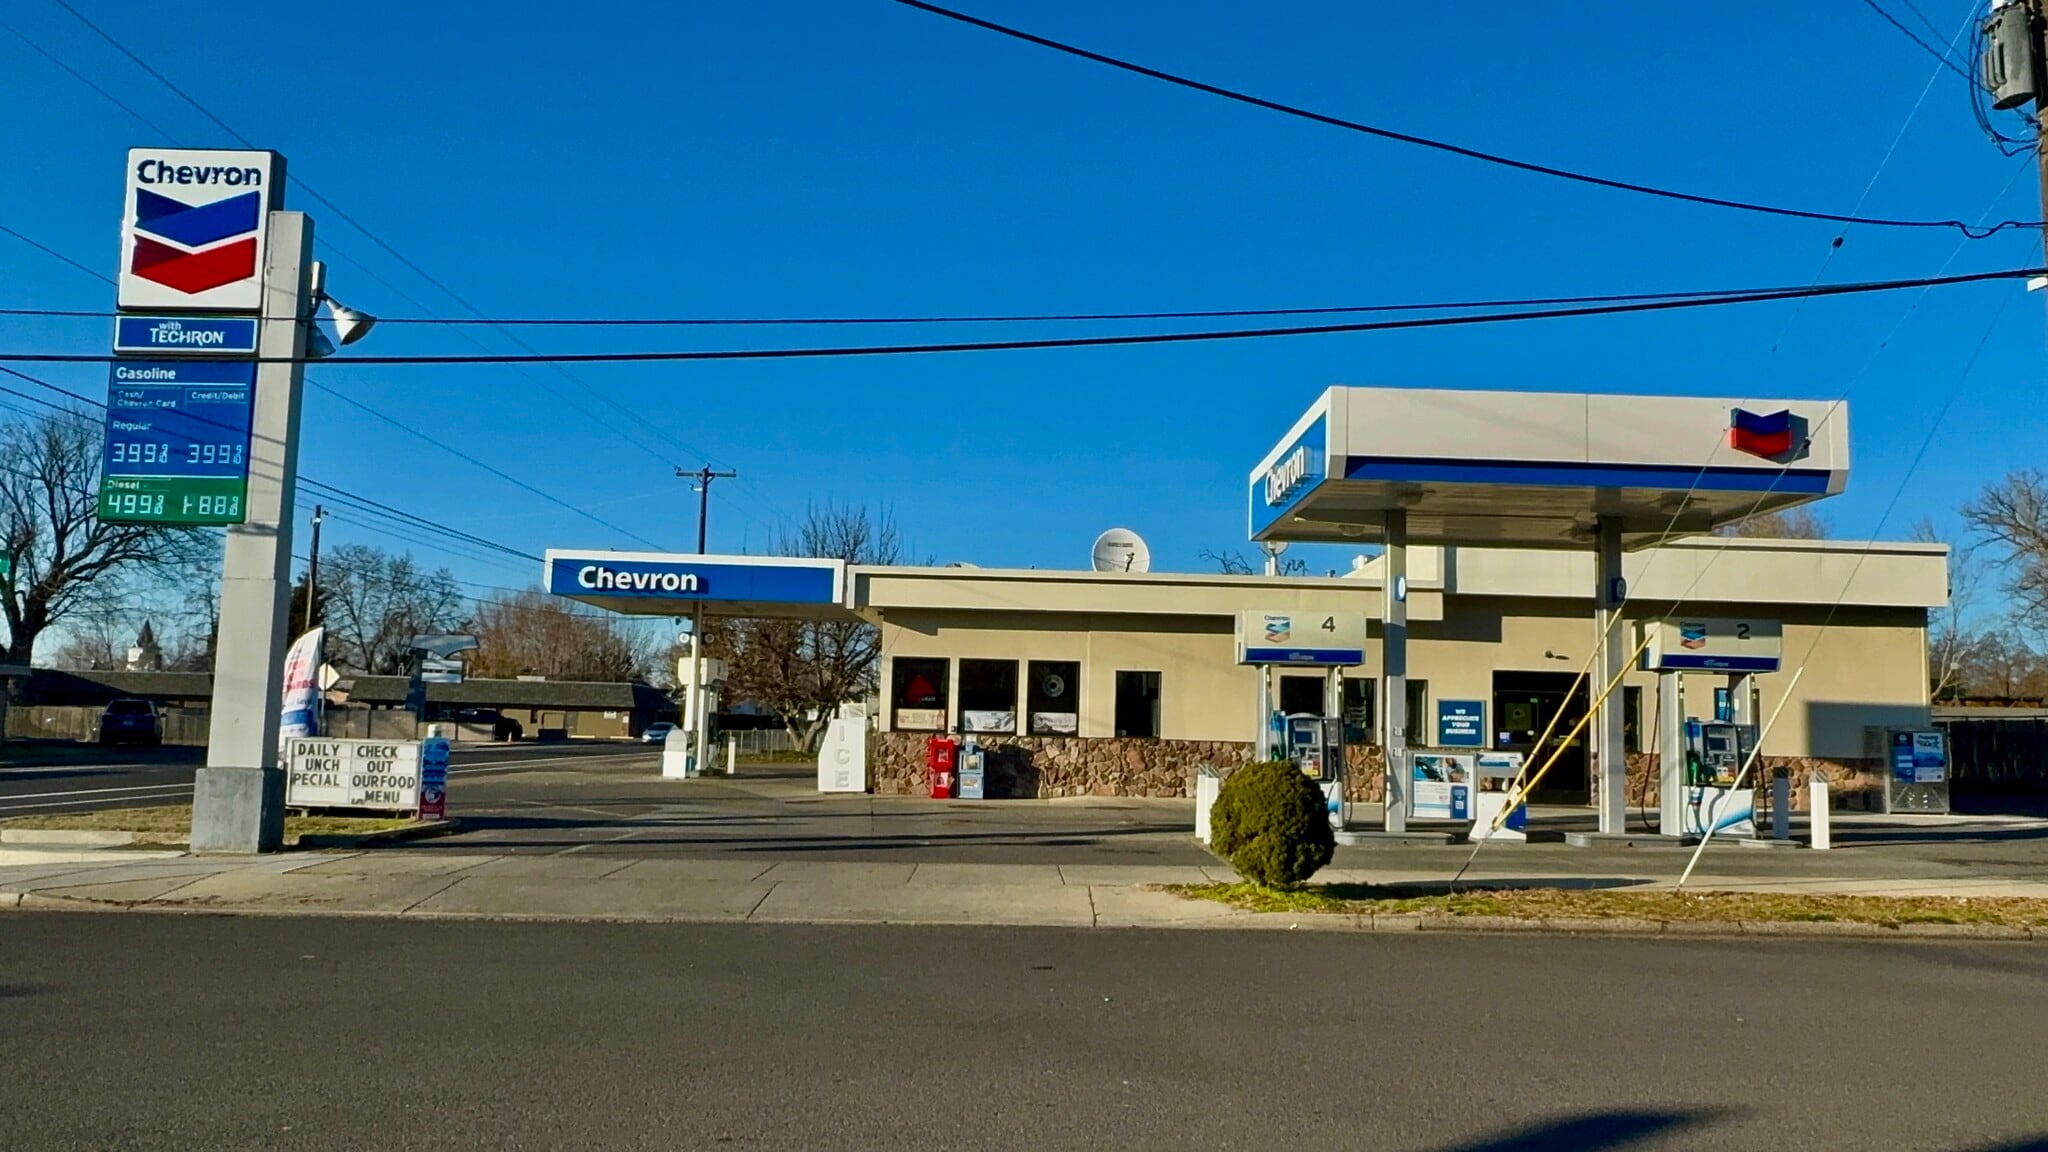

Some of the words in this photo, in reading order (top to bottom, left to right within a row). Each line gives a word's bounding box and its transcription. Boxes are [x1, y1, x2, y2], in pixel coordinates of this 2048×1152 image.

[136, 159, 262, 186] Chevron
[158, 321, 182, 330] with
[150, 328, 224, 346] TECHRON
[116, 367, 176, 380] Gasoline
[191, 391, 245, 400] Credit/Debit
[155, 400, 176, 408] Card
[112, 420, 152, 431] Regular
[112, 443, 156, 463] 399
[186, 444, 231, 464] 399
[1265, 445, 1305, 507] Chevron
[107, 480, 139, 490] Diesel
[108, 494, 152, 514] 499
[577, 565, 698, 591] Chevron
[1321, 616, 1336, 632] 4
[1736, 623, 1751, 640] 2
[298, 743, 340, 756] DAILY
[357, 745, 398, 758] CHECK
[834, 725, 851, 788] ICE
[305, 759, 340, 771] UNCH
[367, 761, 393, 773] OUT
[364, 791, 400, 804] MENU
